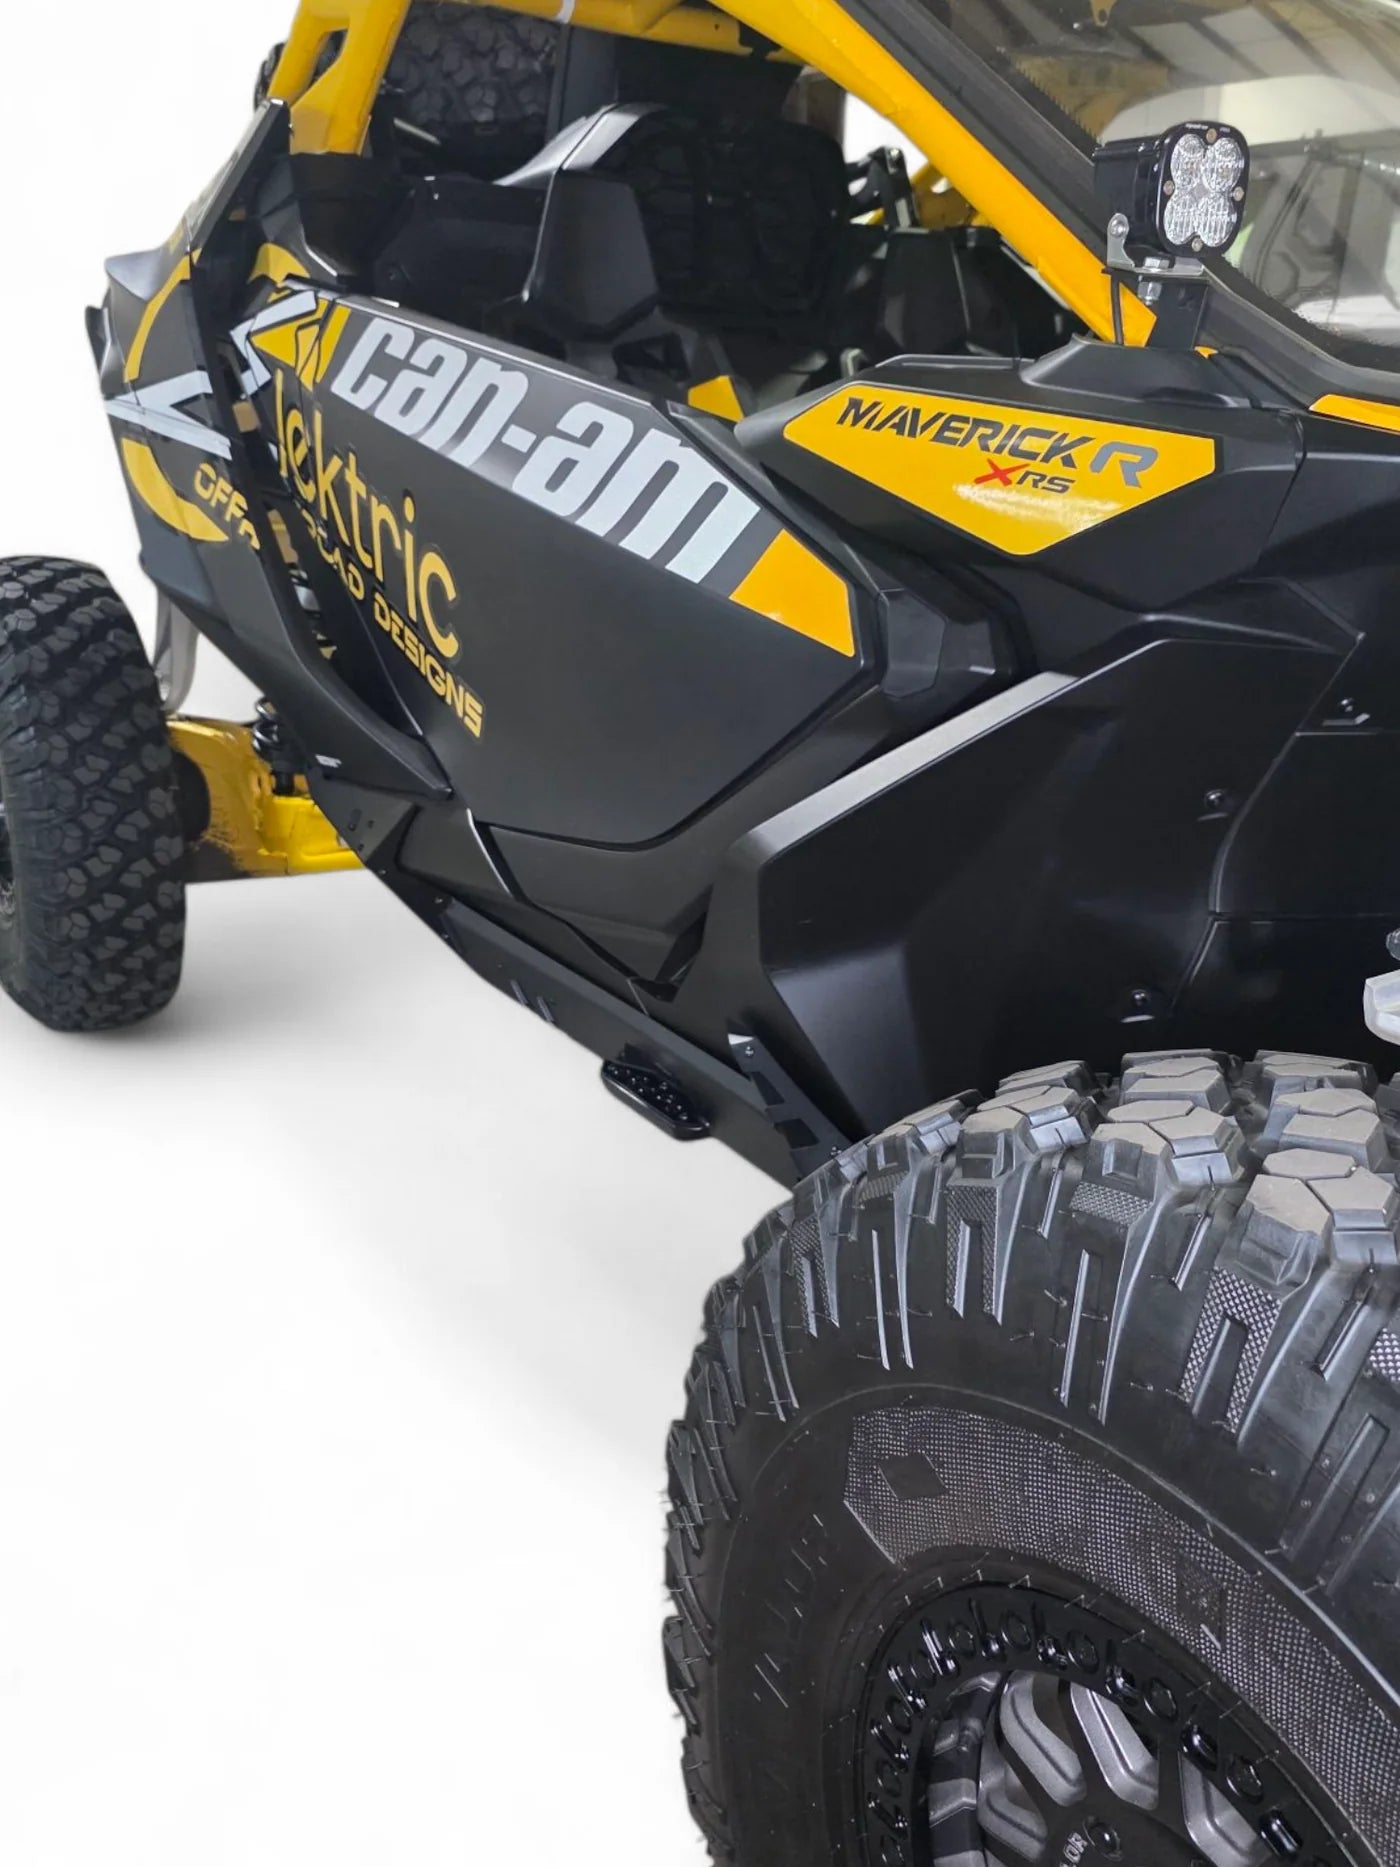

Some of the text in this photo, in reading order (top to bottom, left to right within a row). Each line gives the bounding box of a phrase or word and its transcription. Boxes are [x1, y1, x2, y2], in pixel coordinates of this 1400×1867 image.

[330, 322, 760, 583] can-am
[836, 398, 1158, 488] MAVERICK R
[374, 592, 483, 738] DESIGNS
